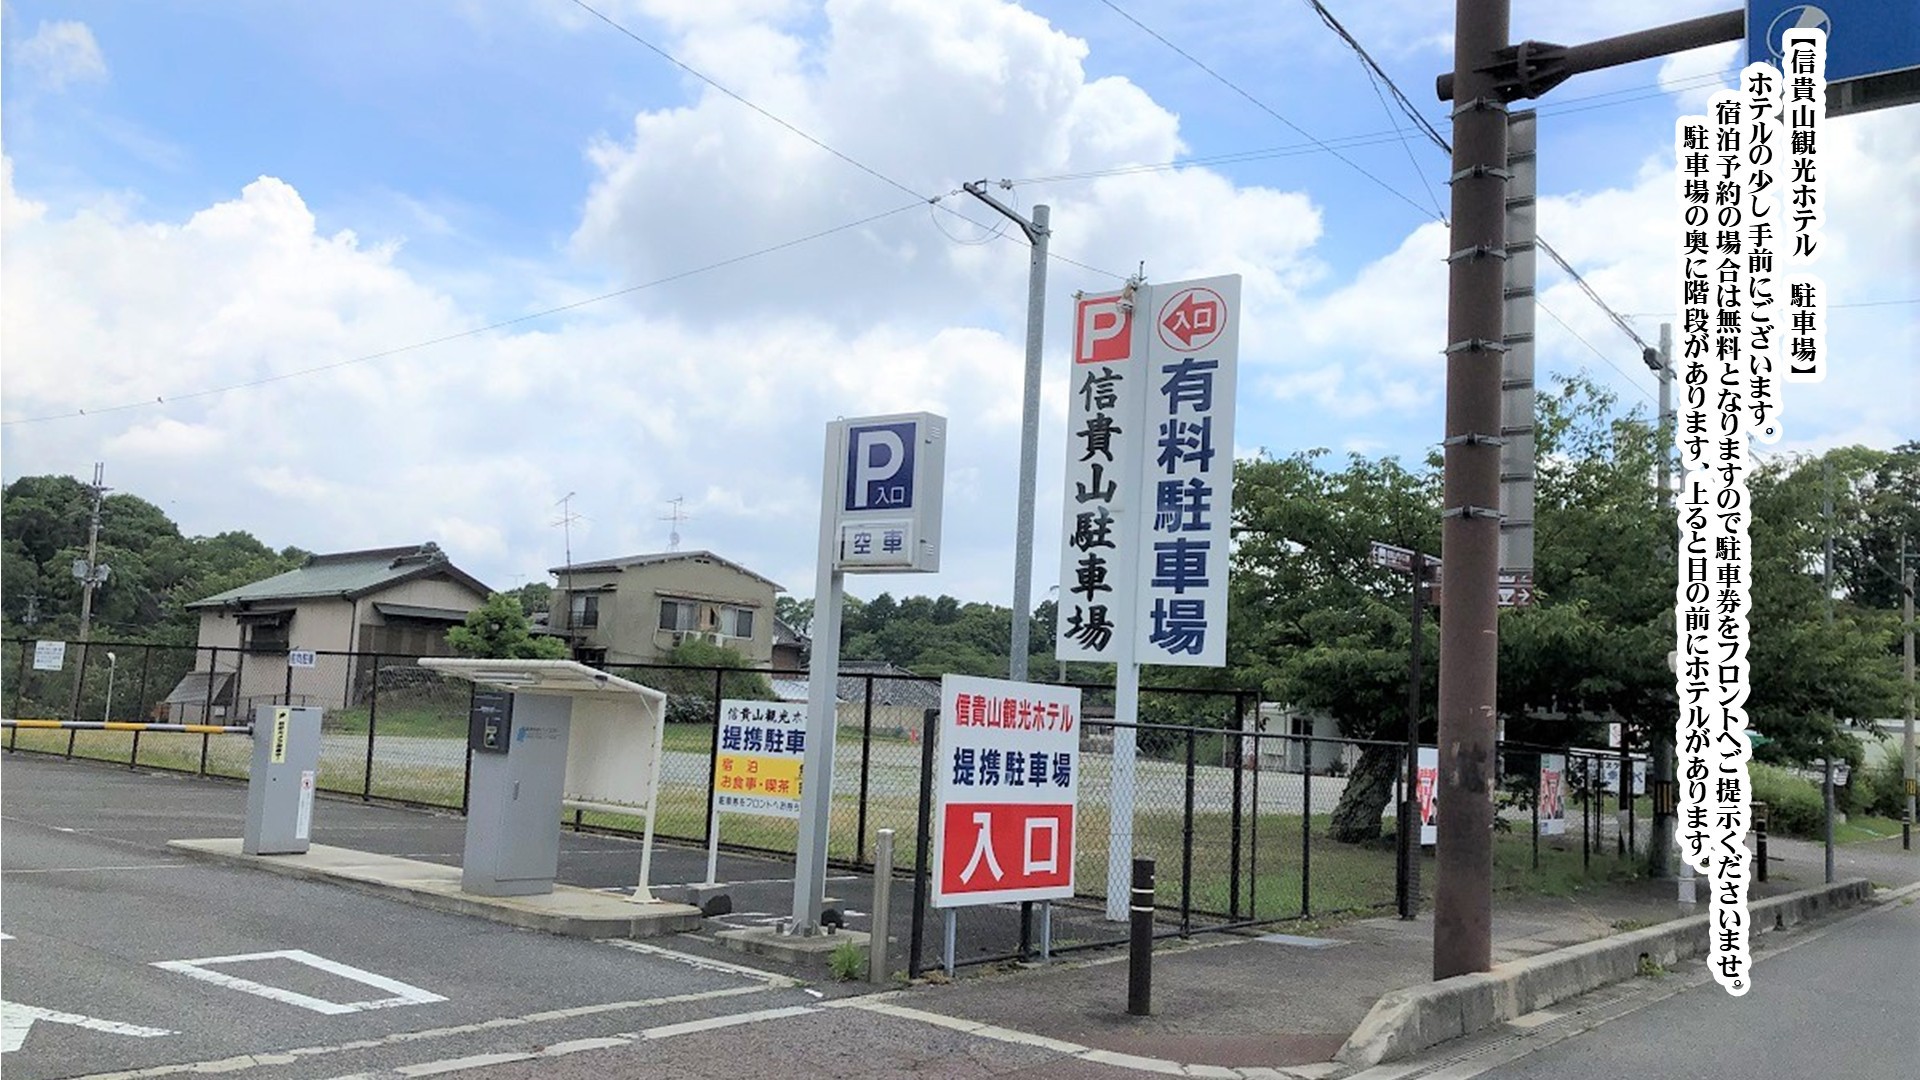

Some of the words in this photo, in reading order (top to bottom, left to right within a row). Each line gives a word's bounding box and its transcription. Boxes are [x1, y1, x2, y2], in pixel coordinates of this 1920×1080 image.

[1081, 303, 1126, 360] P
[1172, 307, 1212, 332] 入口
[854, 430, 905, 508] P
[875, 486, 905, 505] 入口
[1063, 366, 1124, 652] 信貴山駐車場
[1149, 357, 1219, 656] 有料駐車場
[853, 529, 903, 555] 空車
[727, 706, 808, 724] 信貴山観光ホ
[955, 693, 1075, 733] 信貴山観光ホテル
[952, 746, 1072, 789] 提携駐車場
[959, 811, 1061, 885] 入口
